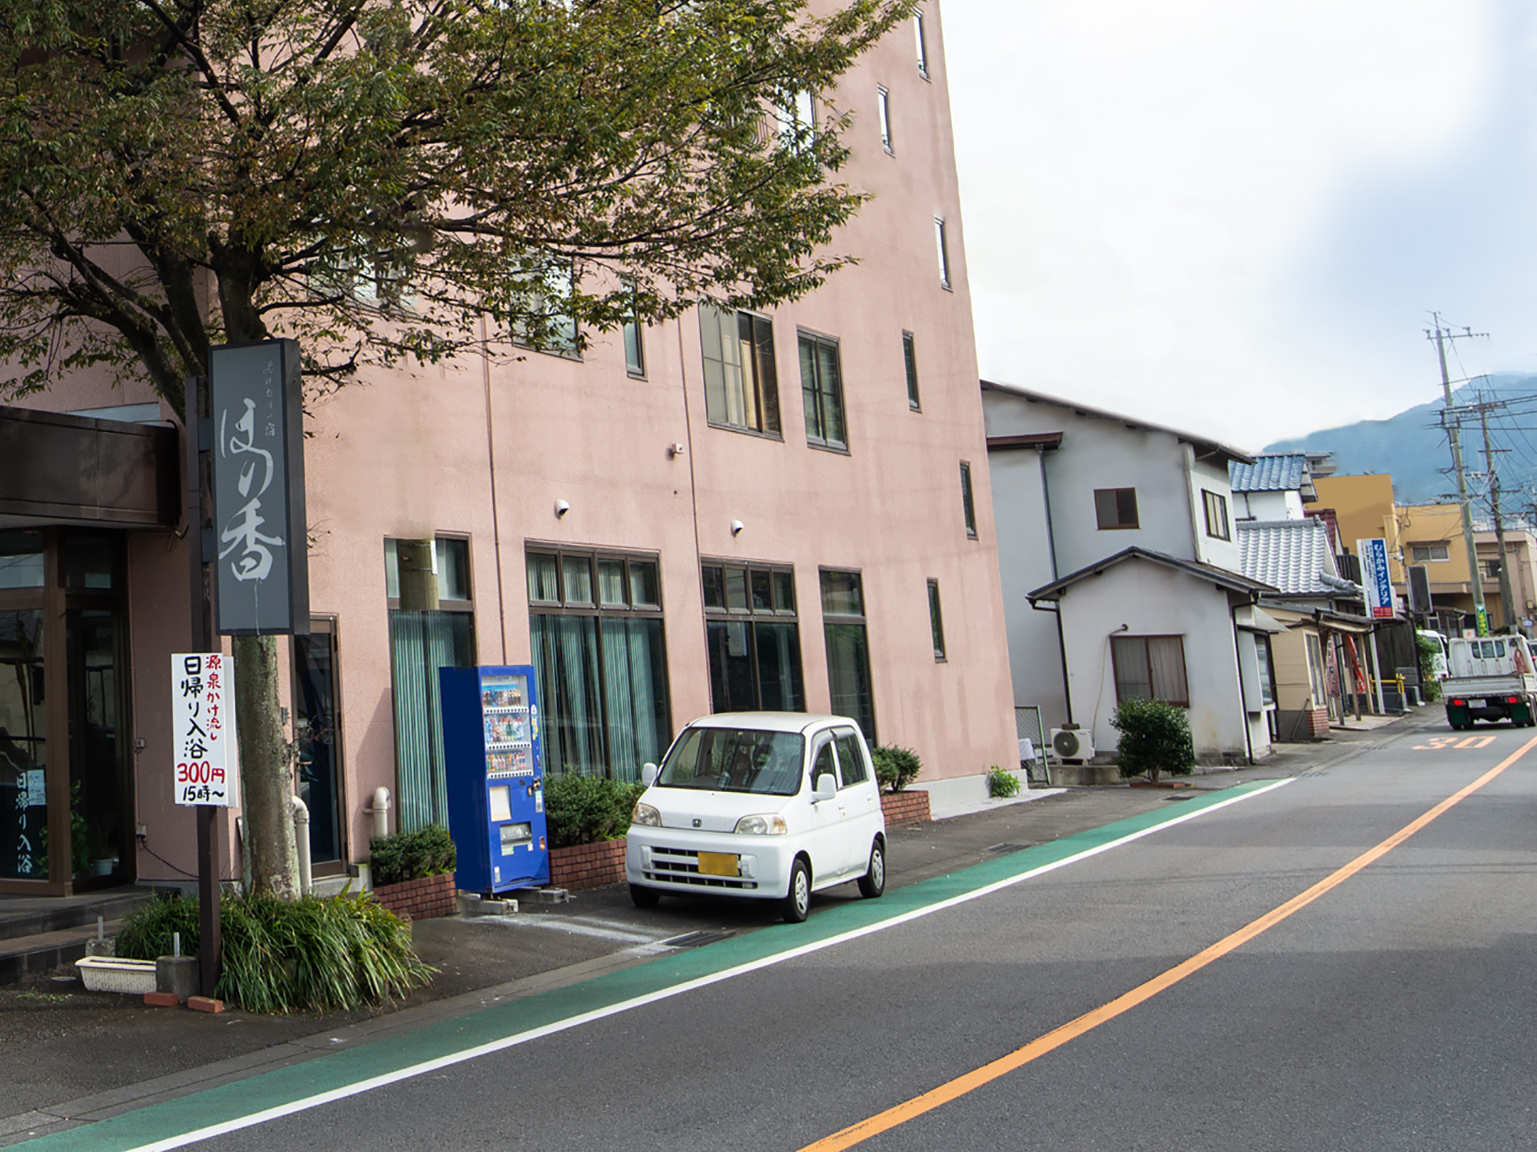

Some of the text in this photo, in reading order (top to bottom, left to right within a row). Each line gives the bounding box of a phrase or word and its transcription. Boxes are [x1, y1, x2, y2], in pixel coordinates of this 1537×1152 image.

[219, 398, 286, 581] ほの香
[181, 656, 208, 759] 日帰り入浴
[206, 655, 222, 741] 源泉かけ流し
[1412, 735, 1497, 750] 30
[177, 761, 225, 784] 300円
[15, 772, 33, 873] 日帰り入浴
